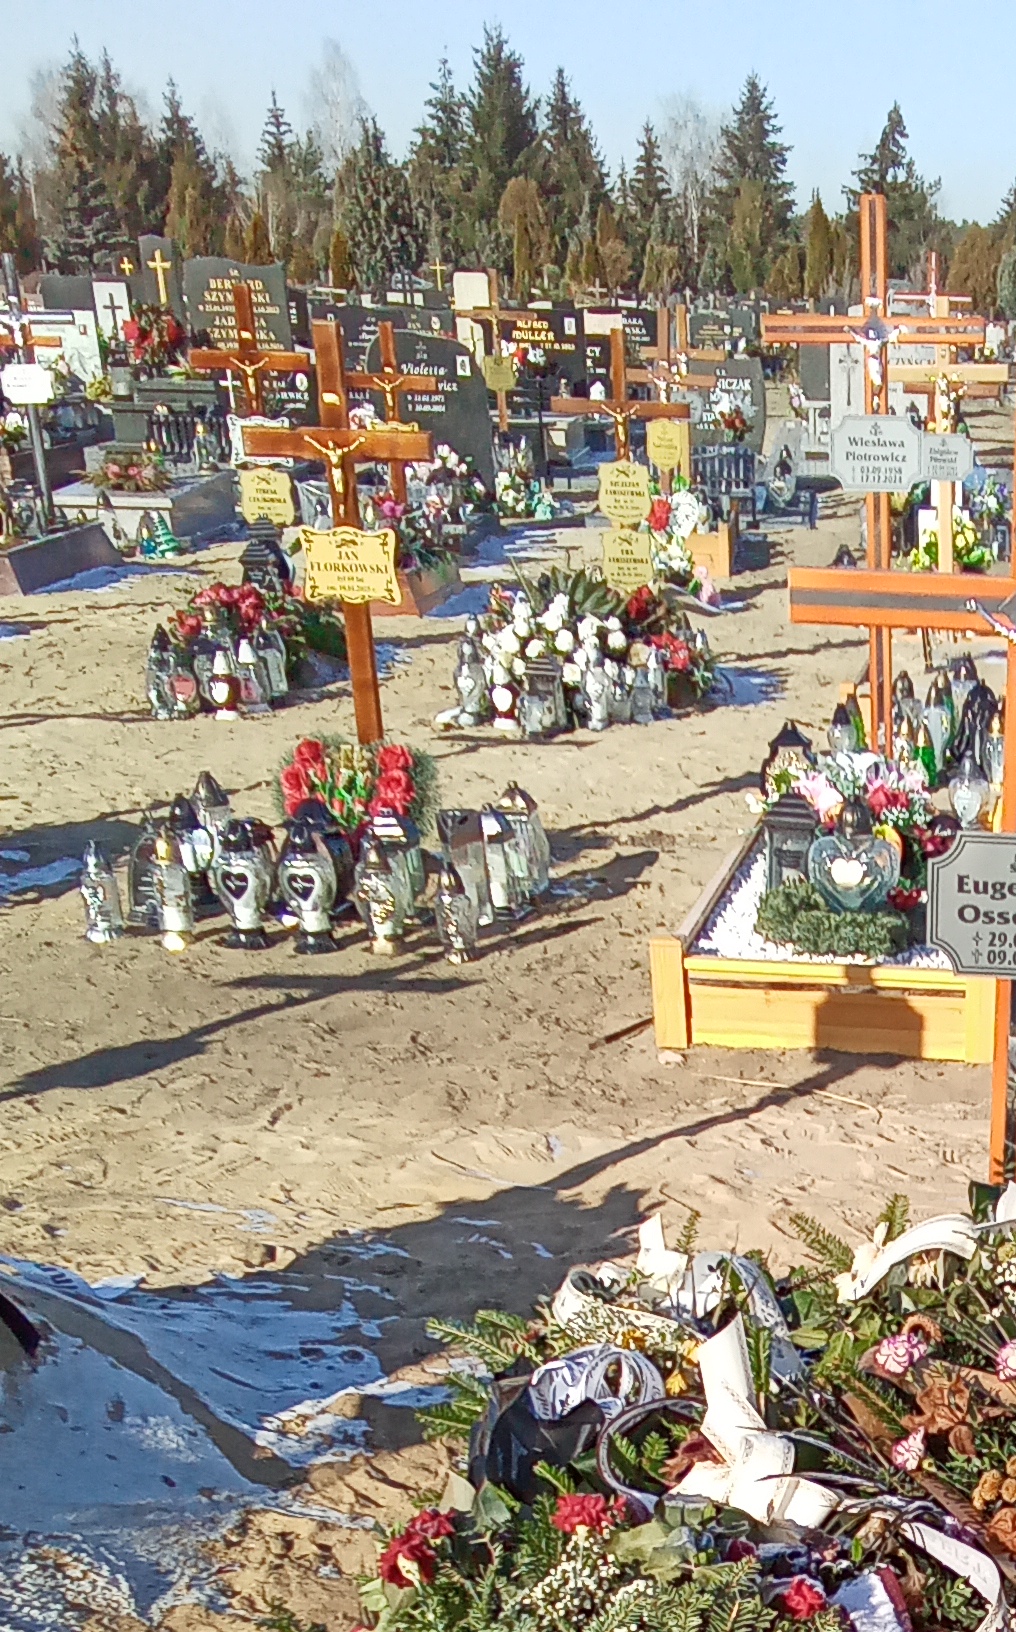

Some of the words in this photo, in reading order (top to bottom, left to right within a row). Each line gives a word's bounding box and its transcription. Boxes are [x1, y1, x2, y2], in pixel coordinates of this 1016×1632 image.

[209, 278, 263, 290] BERNRD
[204, 291, 270, 303] SZYMSKI
[207, 328, 276, 340] SZYMSKA
[848, 436, 905, 448] Wiesława
[846, 451, 907, 462] Piotrowicz
[337, 551, 359, 560] JAN
[310, 562, 388, 574] FLORKOWSKI
